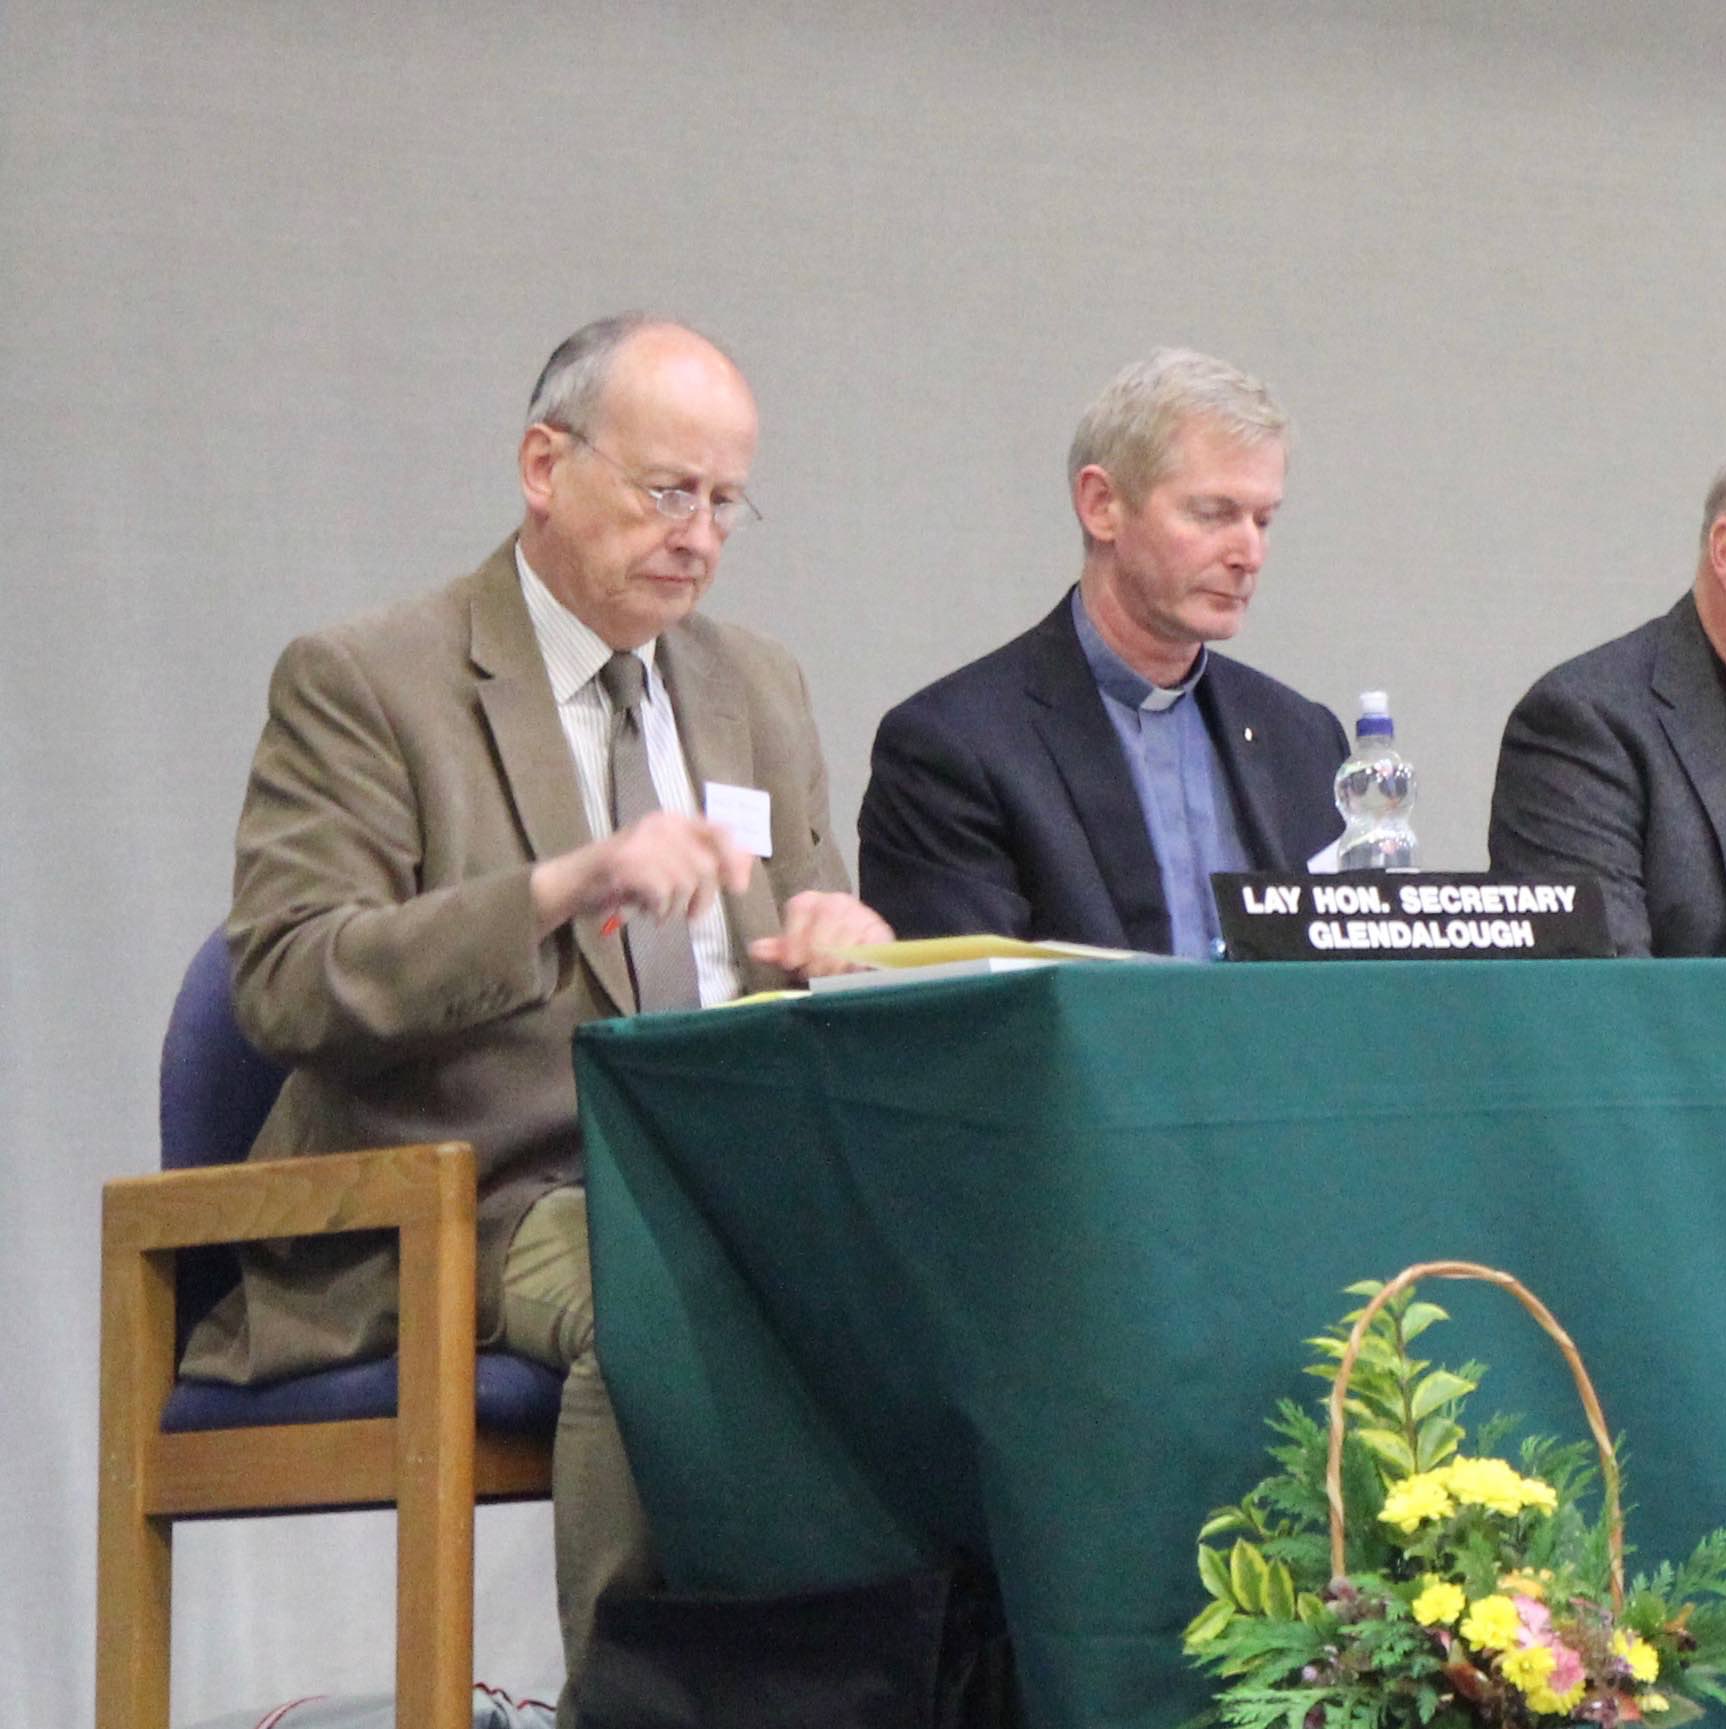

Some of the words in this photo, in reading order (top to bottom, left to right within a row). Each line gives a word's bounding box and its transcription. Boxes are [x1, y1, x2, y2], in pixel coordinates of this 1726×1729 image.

[1242, 886, 1301, 914] LAY
[1312, 885, 1391, 915] HON.
[1399, 885, 1576, 914] SECRETARY
[1308, 919, 1535, 950] GLENDALOUGH
